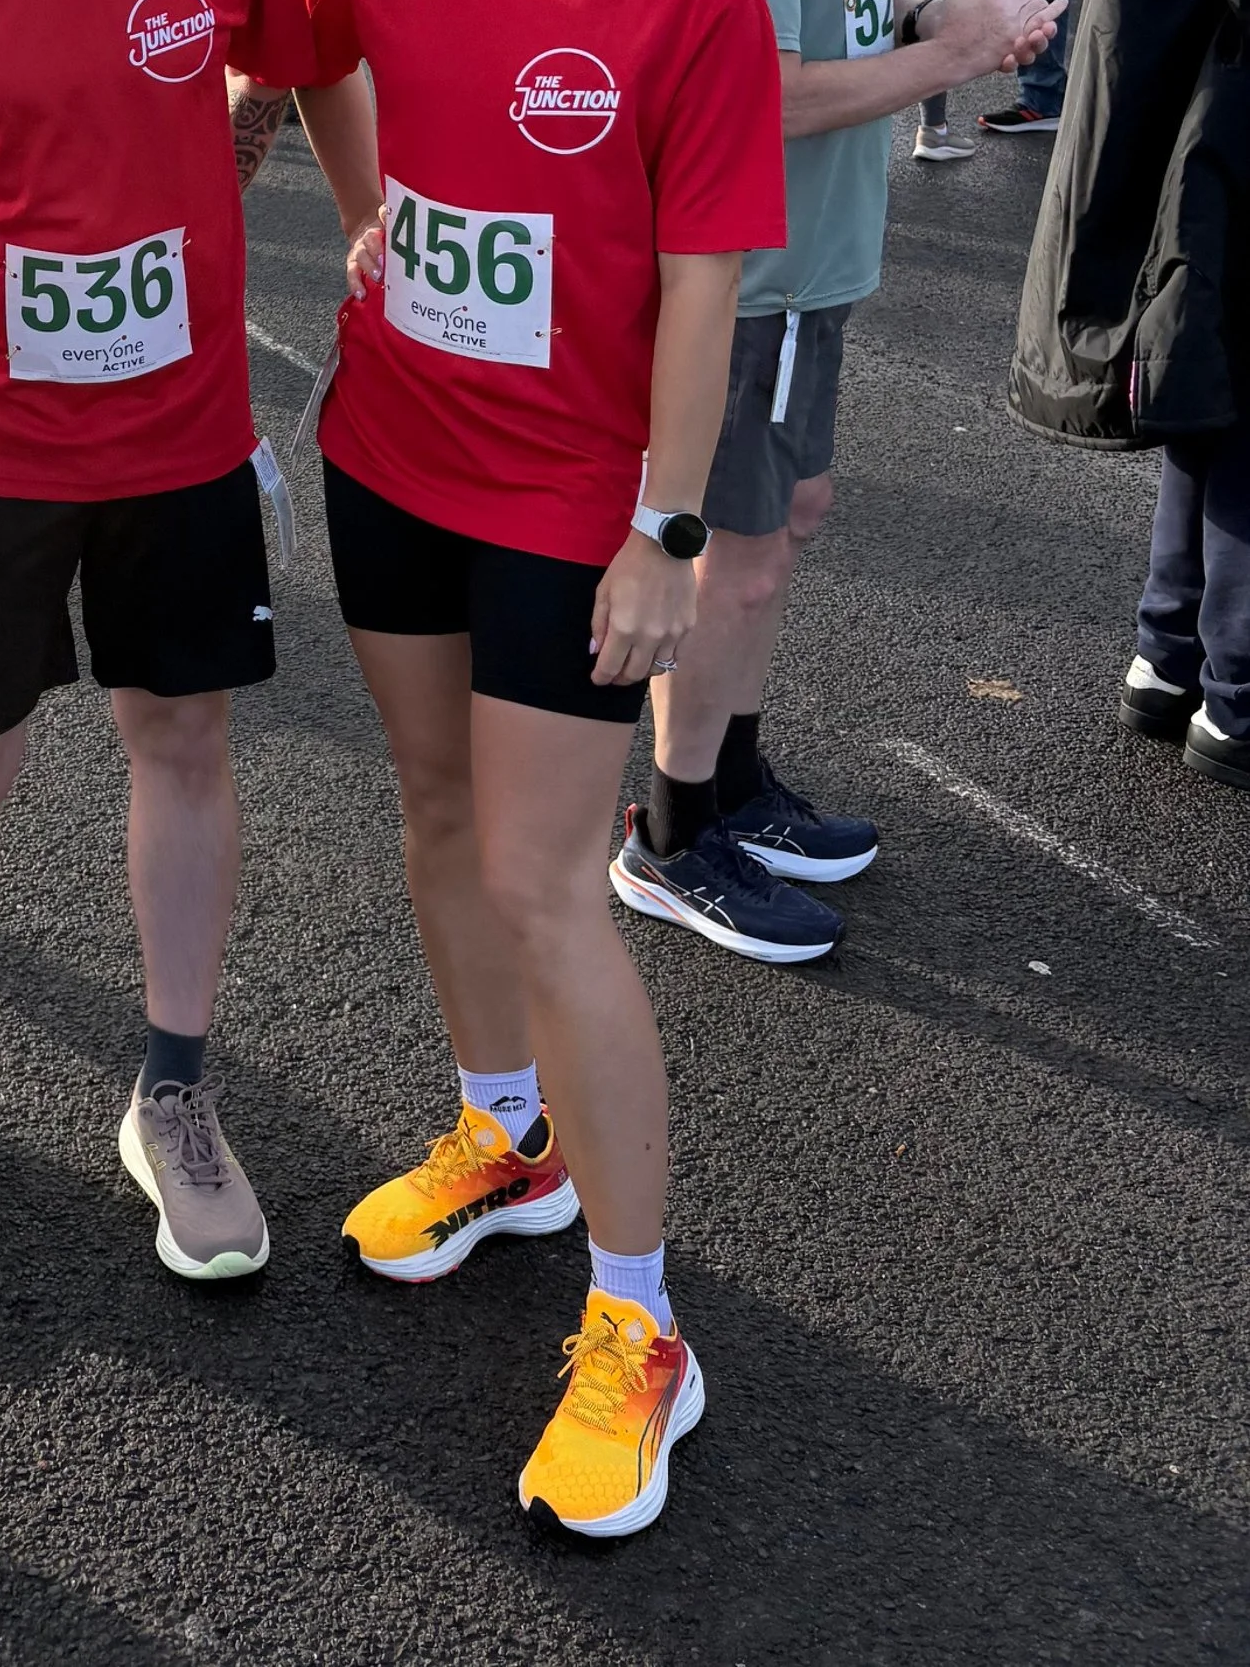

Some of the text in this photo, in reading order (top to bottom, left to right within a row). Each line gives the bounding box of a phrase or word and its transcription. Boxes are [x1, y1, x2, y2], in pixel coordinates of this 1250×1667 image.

[128, 8, 216, 66] JUNCTION
[144, 12, 169, 30] THE
[534, 75, 563, 89] THE
[508, 86, 621, 122] JUNCTION
[391, 195, 534, 306] 456
[20, 239, 174, 333] 536
[411, 300, 487, 334] everyone
[62, 334, 145, 362] everyone
[442, 330, 487, 348] ACTIVE
[102, 355, 146, 372] ACTIVE
[419, 1177, 531, 1253] NITRO
